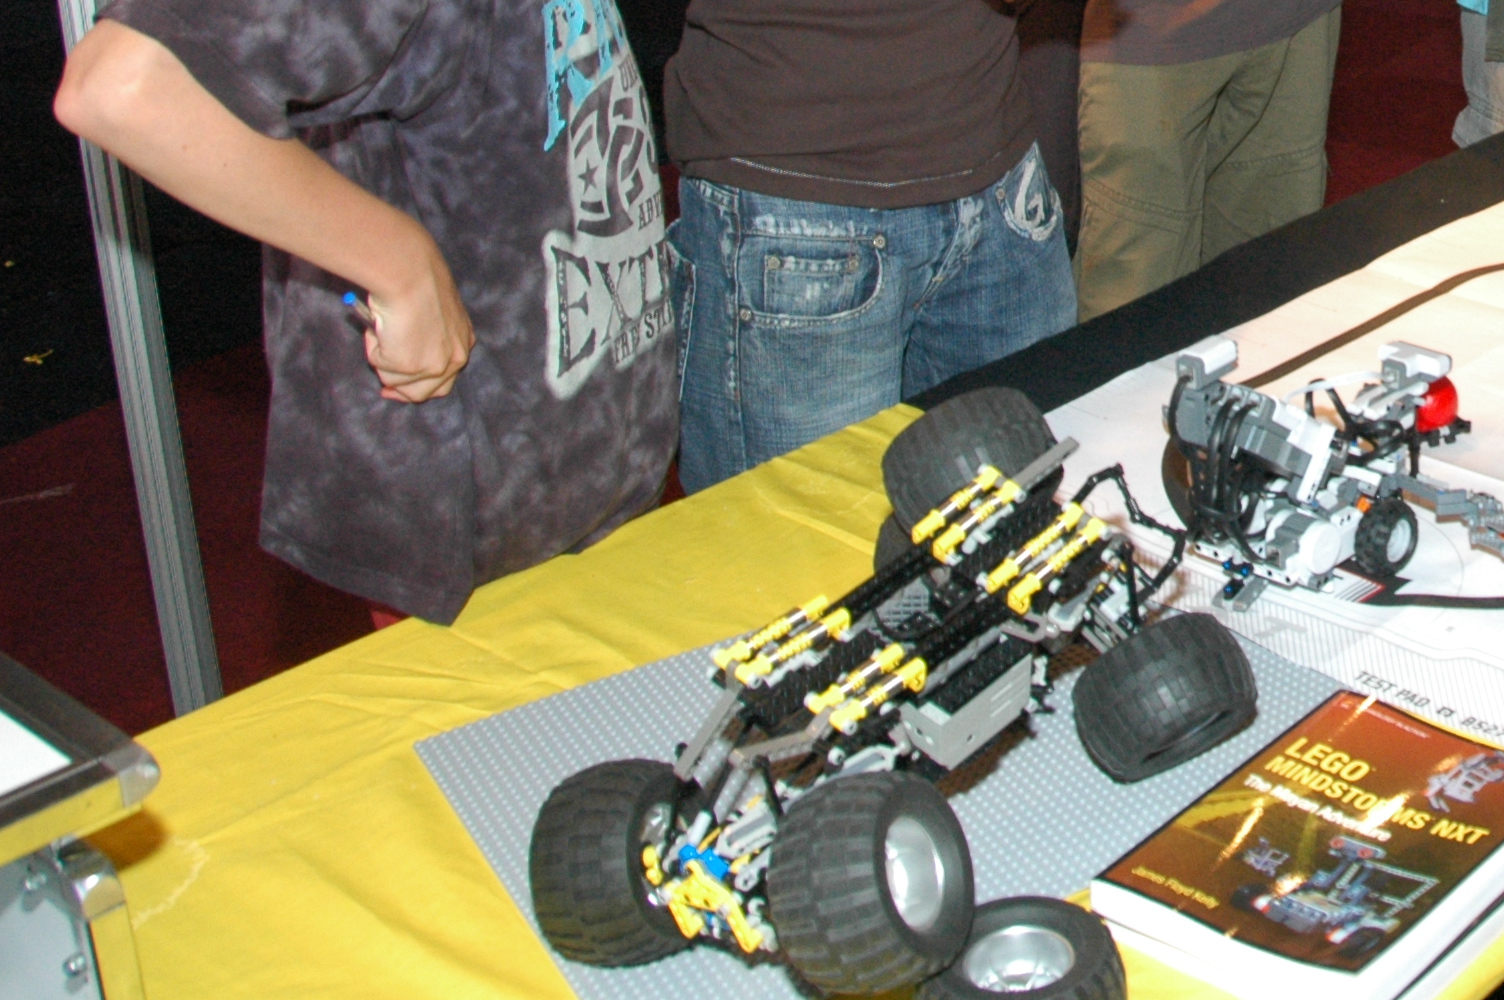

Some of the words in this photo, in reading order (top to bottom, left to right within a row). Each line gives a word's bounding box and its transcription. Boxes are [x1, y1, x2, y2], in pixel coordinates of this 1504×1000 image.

[1355, 671, 1397, 693] TEST
[1395, 687, 1431, 708] PAD
[1284, 737, 1371, 782] LEGO
[1244, 773, 1272, 792] The
[1264, 755, 1431, 830] MINDSTOMS
[1429, 818, 1490, 845] NXT
